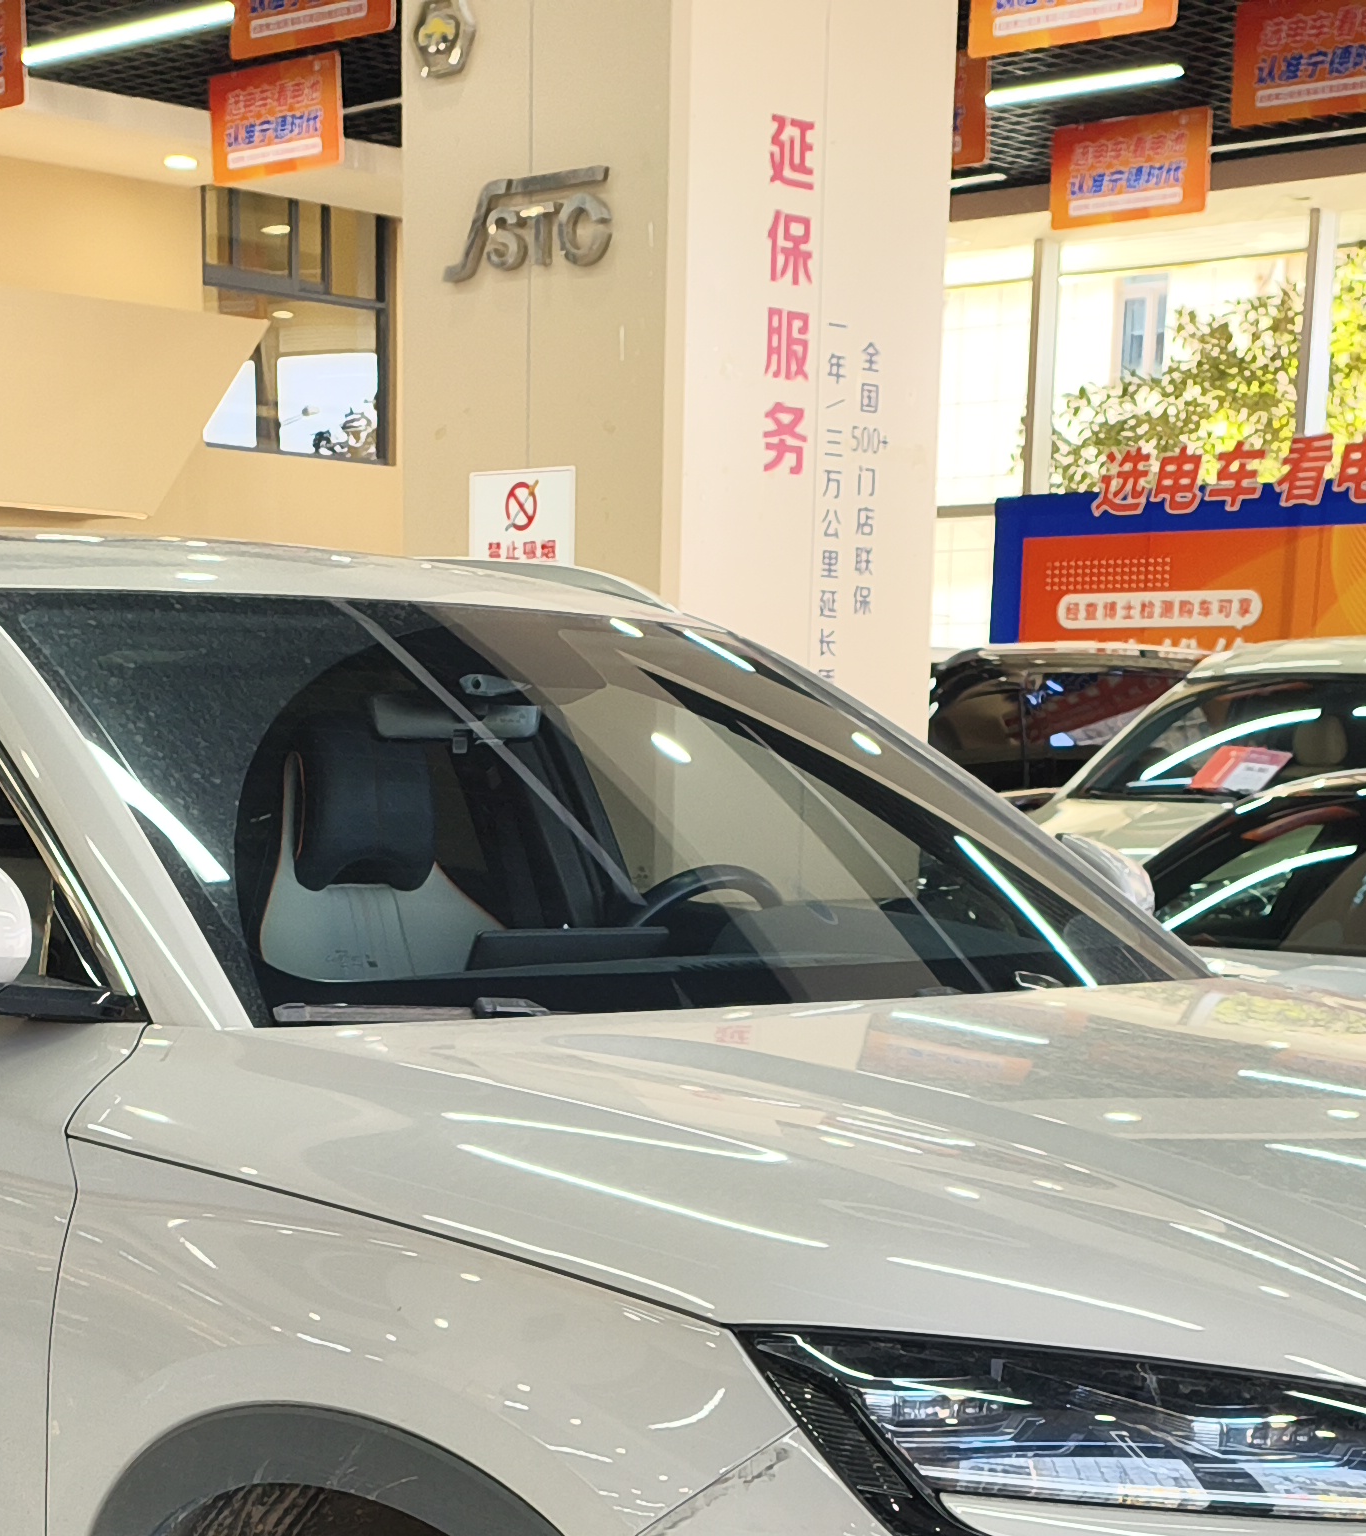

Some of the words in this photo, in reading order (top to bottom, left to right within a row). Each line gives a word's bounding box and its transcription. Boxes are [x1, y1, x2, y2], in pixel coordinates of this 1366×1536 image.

[762, 113, 815, 475] 延保服务
[487, 539, 557, 562] 禁止吸烟
